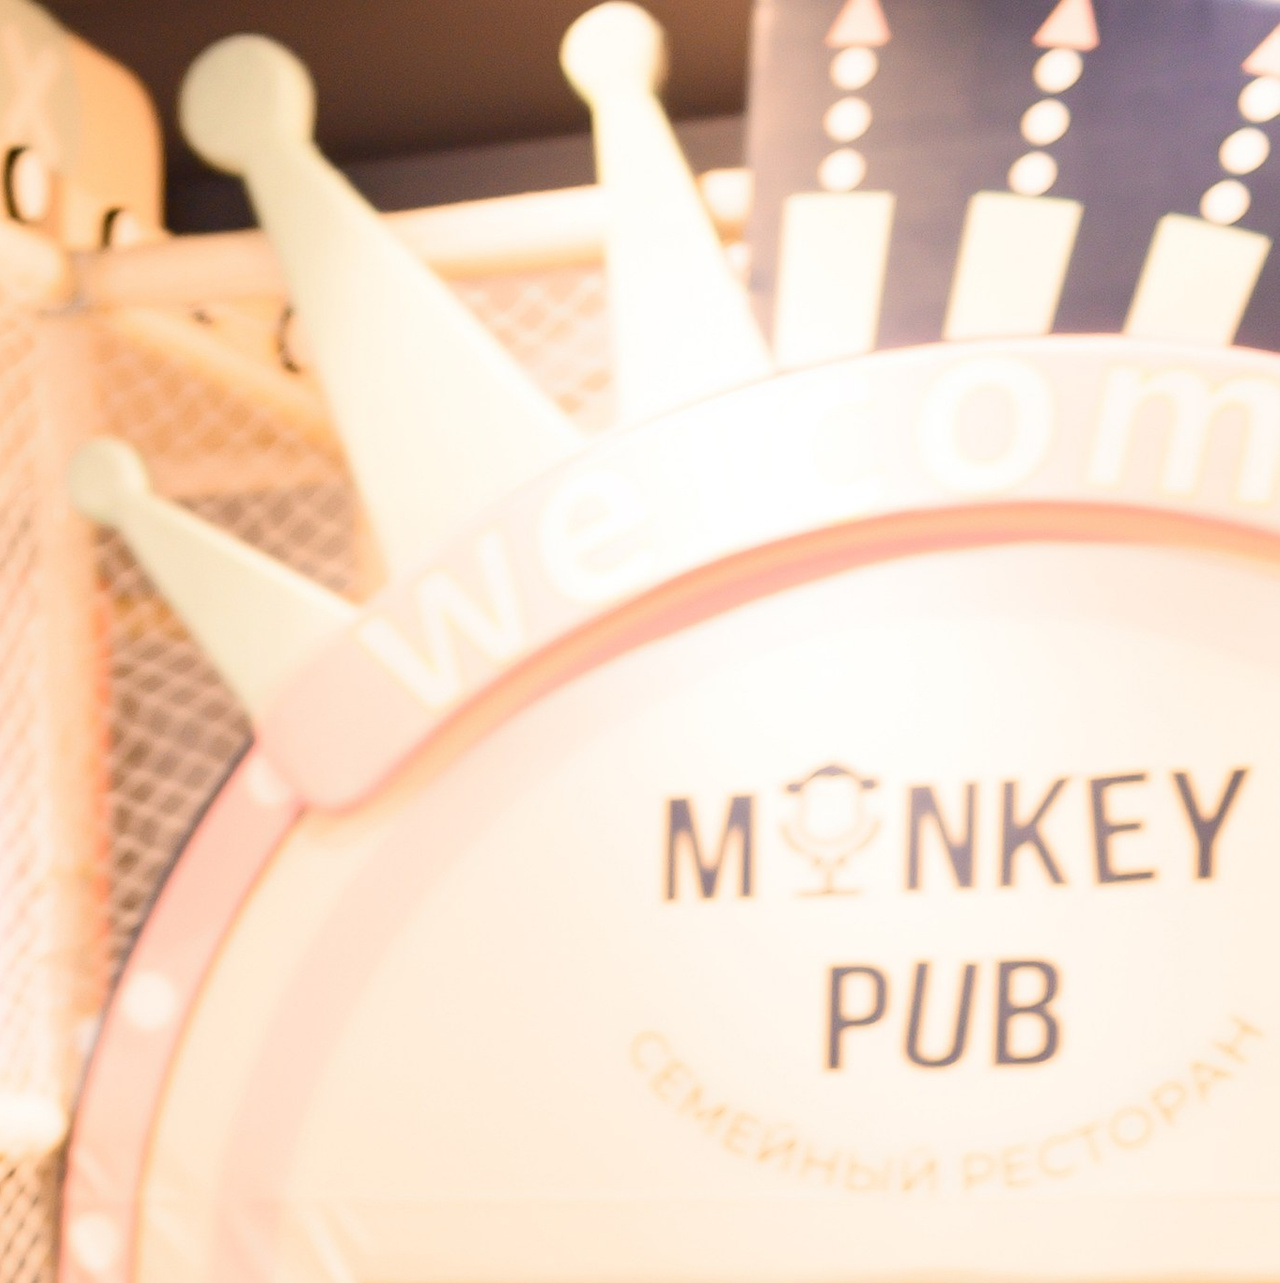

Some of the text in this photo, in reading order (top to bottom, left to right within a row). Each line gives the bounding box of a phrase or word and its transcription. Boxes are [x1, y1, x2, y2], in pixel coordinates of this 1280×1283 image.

[824, 958, 1063, 1071] PUB
[628, 1014, 1264, 1193] СЕМЕЙНЫЙ РЕСТОРАН
